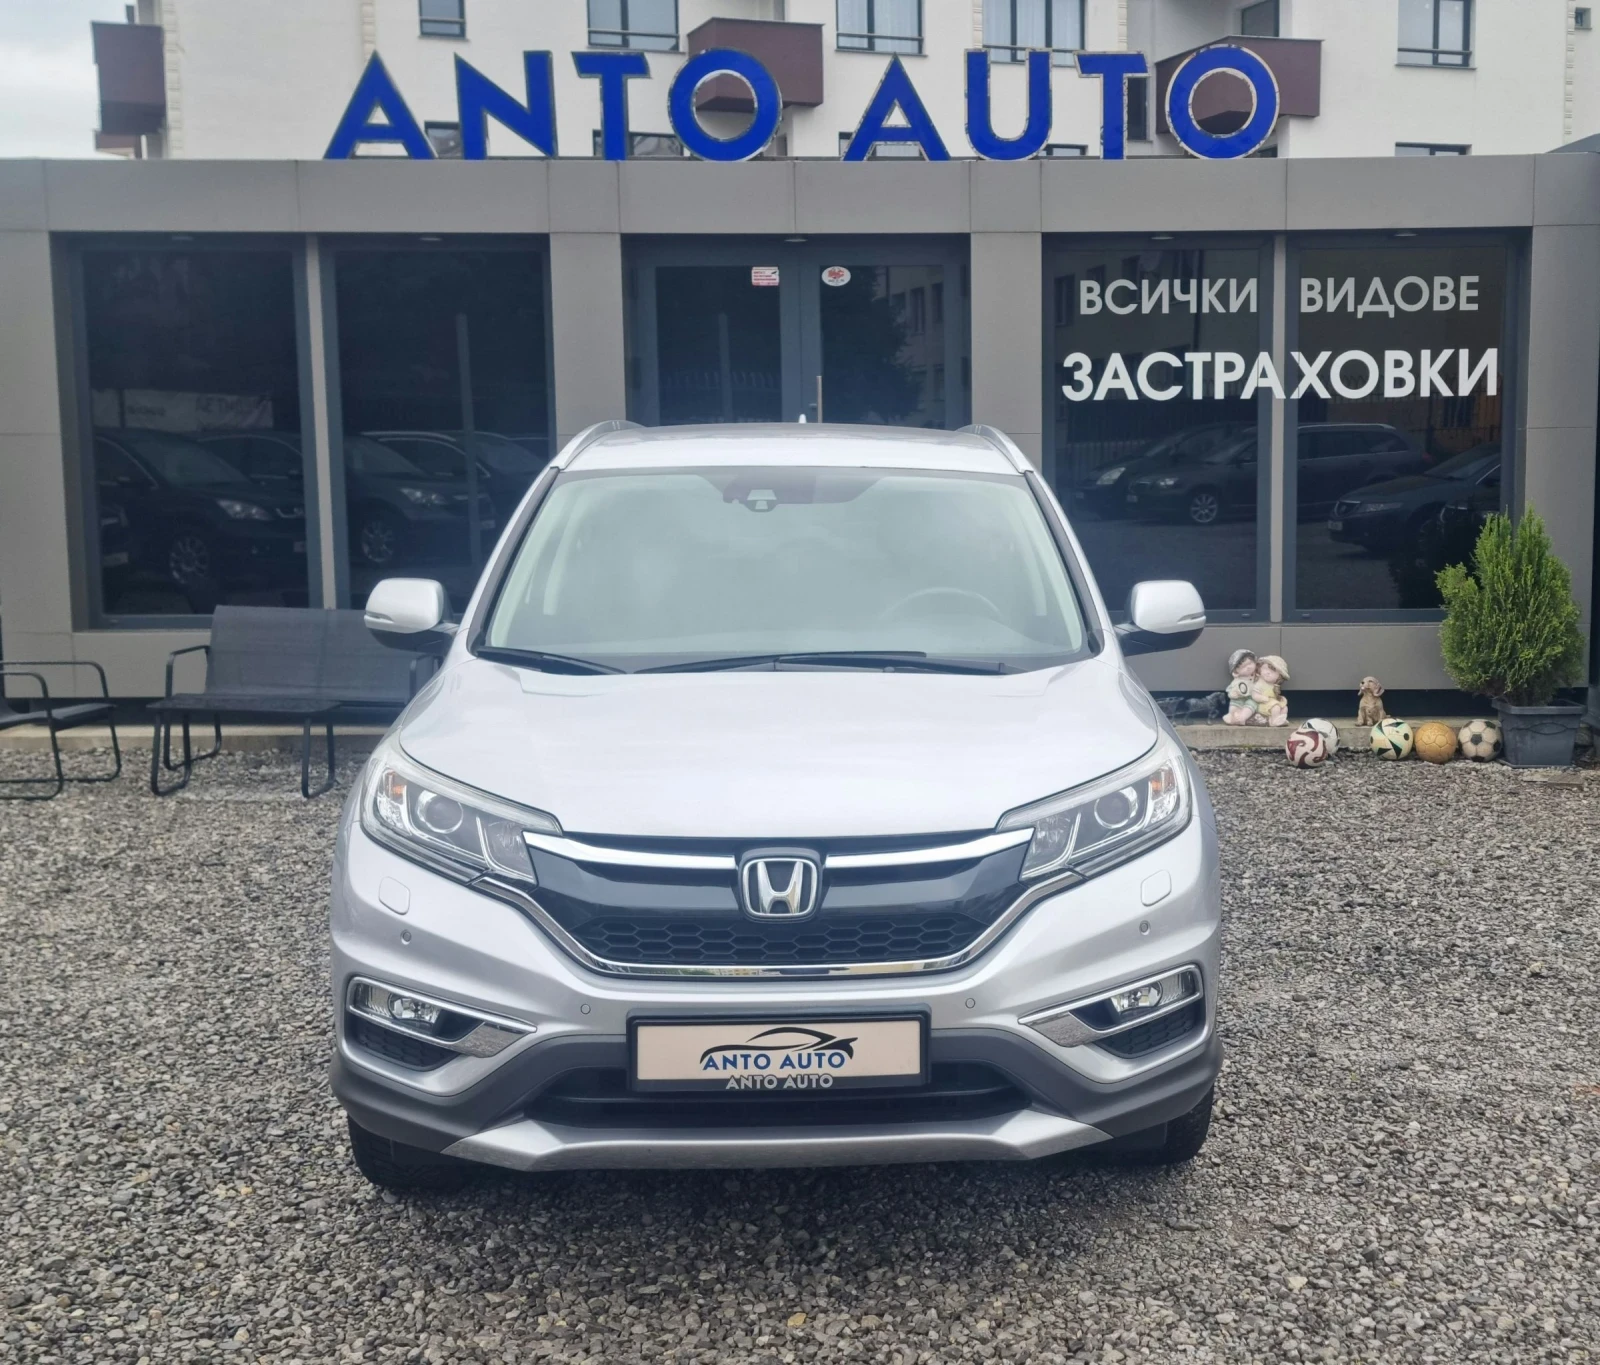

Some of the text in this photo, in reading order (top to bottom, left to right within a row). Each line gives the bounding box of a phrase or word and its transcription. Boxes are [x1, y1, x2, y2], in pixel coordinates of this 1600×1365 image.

[324, 44, 1280, 162] ANTO AUTO
[1079, 275, 1480, 319] ВСИЧКИ ВИДОВЕ
[1062, 348, 1498, 402] ЗАСТРАХОВКИ
[703, 1051, 846, 1070] ANTO AUTO
[725, 1073, 834, 1090] ANTO AUTO
